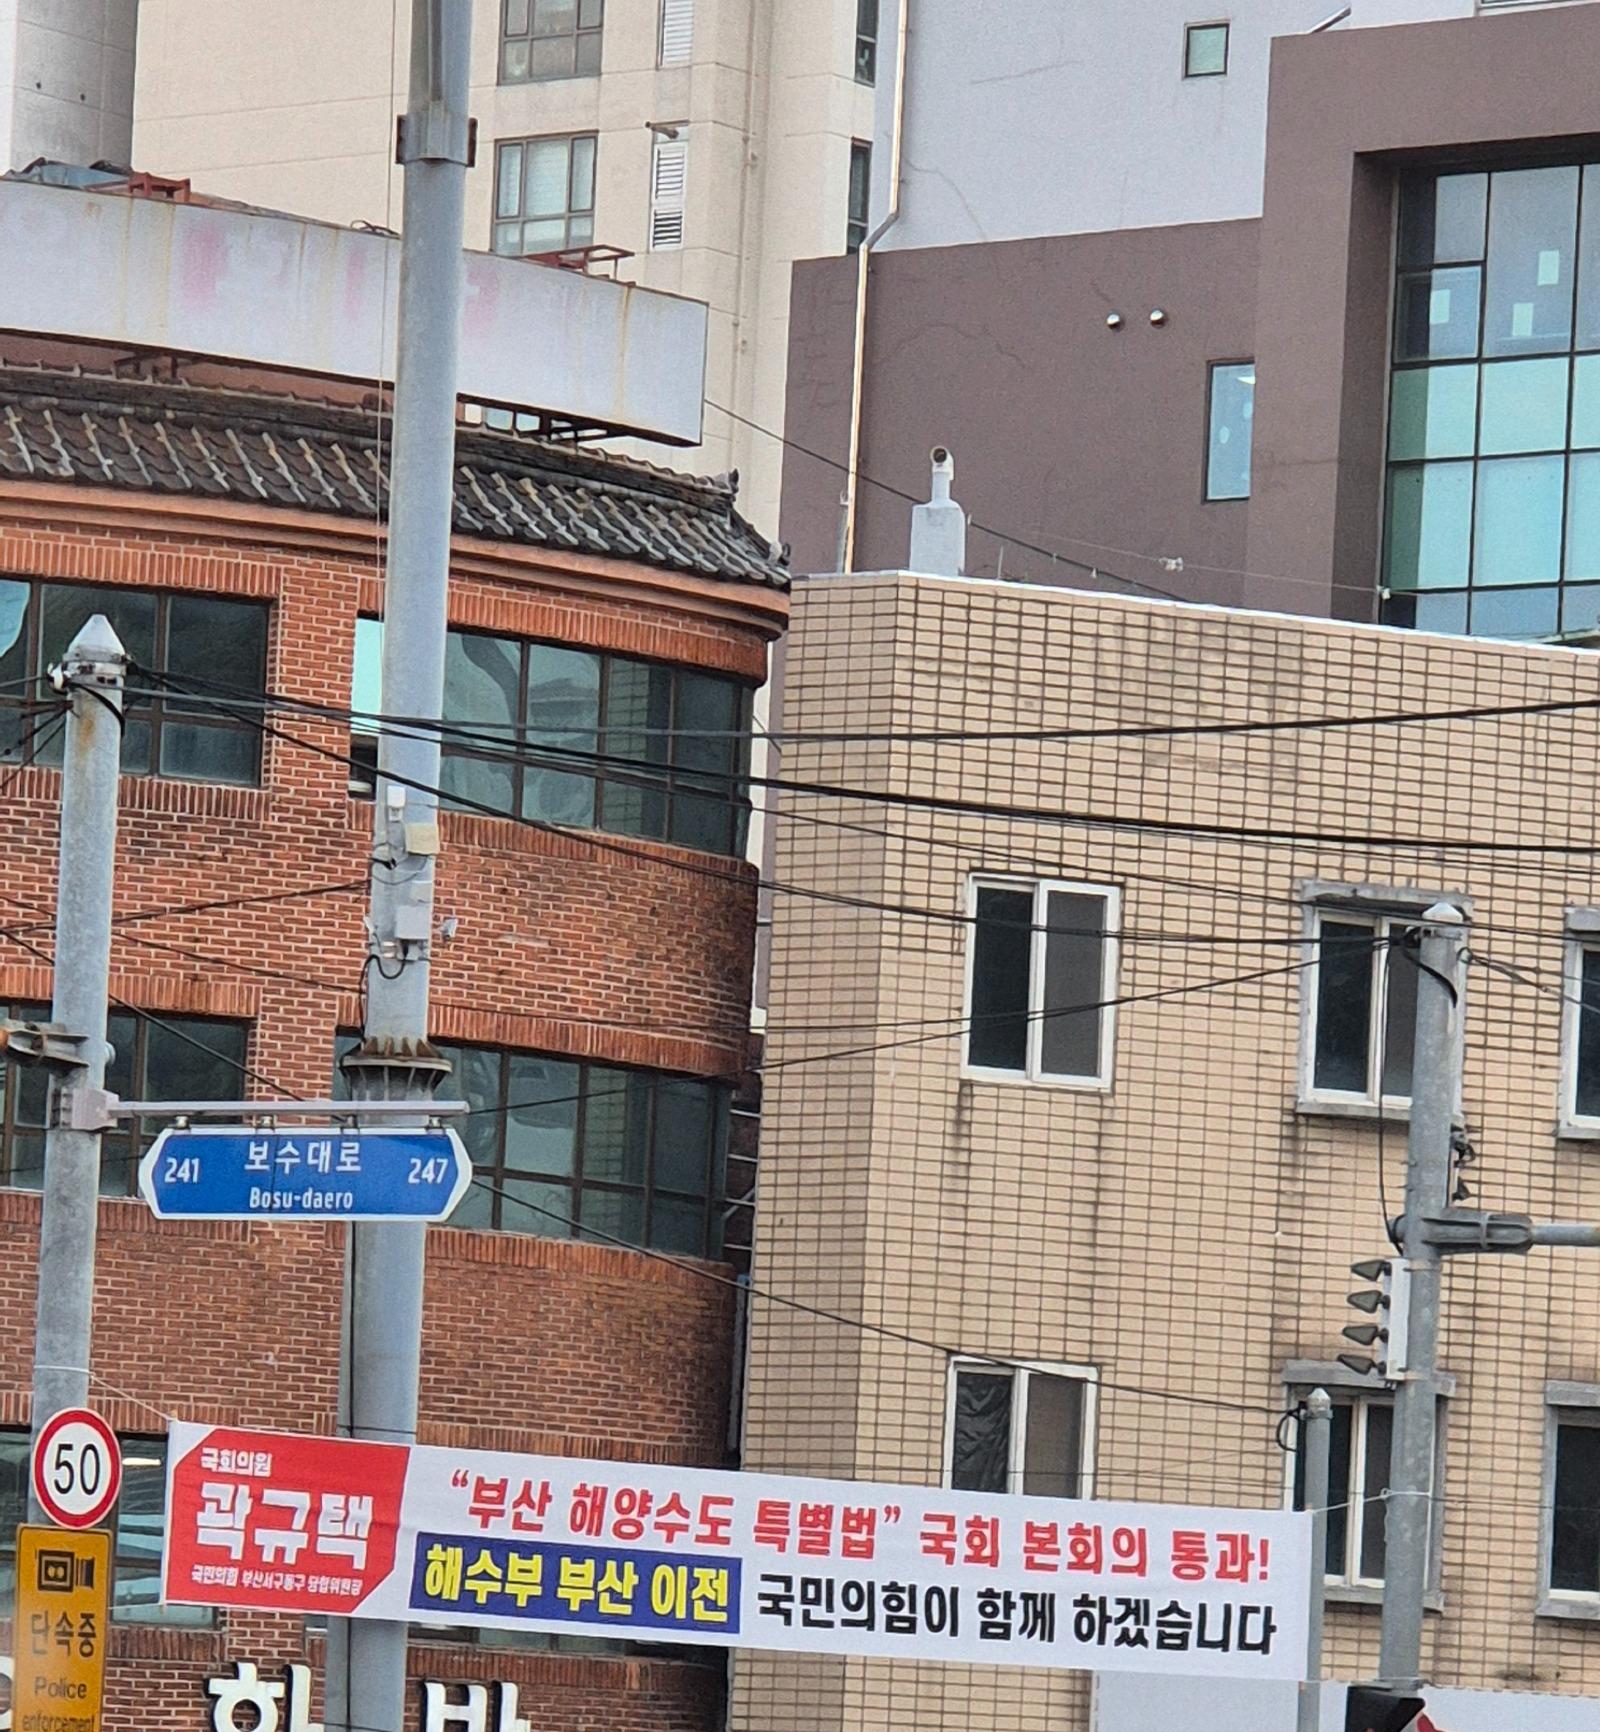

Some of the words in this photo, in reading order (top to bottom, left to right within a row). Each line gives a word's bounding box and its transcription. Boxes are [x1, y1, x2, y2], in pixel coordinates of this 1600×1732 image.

[164, 1158, 199, 1184] 241
[244, 1141, 361, 1175] 보수대로
[407, 1158, 448, 1185] 247
[249, 1187, 353, 1209] Bosu-daero
[54, 1443, 101, 1496] 50
[201, 1447, 272, 1477] 국회의원
[196, 1481, 374, 1570] 곽규택
[568, 1482, 736, 1546] 해양수도
[919, 1513, 1001, 1569] 국회
[1023, 1519, 1148, 1577] 본회의
[1170, 1529, 1270, 1583] 통과!
[191, 1564, 239, 1587] 국민의힘
[424, 1543, 543, 1608] 해수부
[557, 1555, 639, 1615] 부산
[650, 1563, 730, 1624] 이전
[757, 1573, 960, 1638] 국민의힘이
[976, 1586, 1056, 1643] 함께
[1072, 1593, 1278, 1655] 하겠습니다
[30, 1608, 97, 1658] 단속중
[34, 1675, 88, 1700] Police
